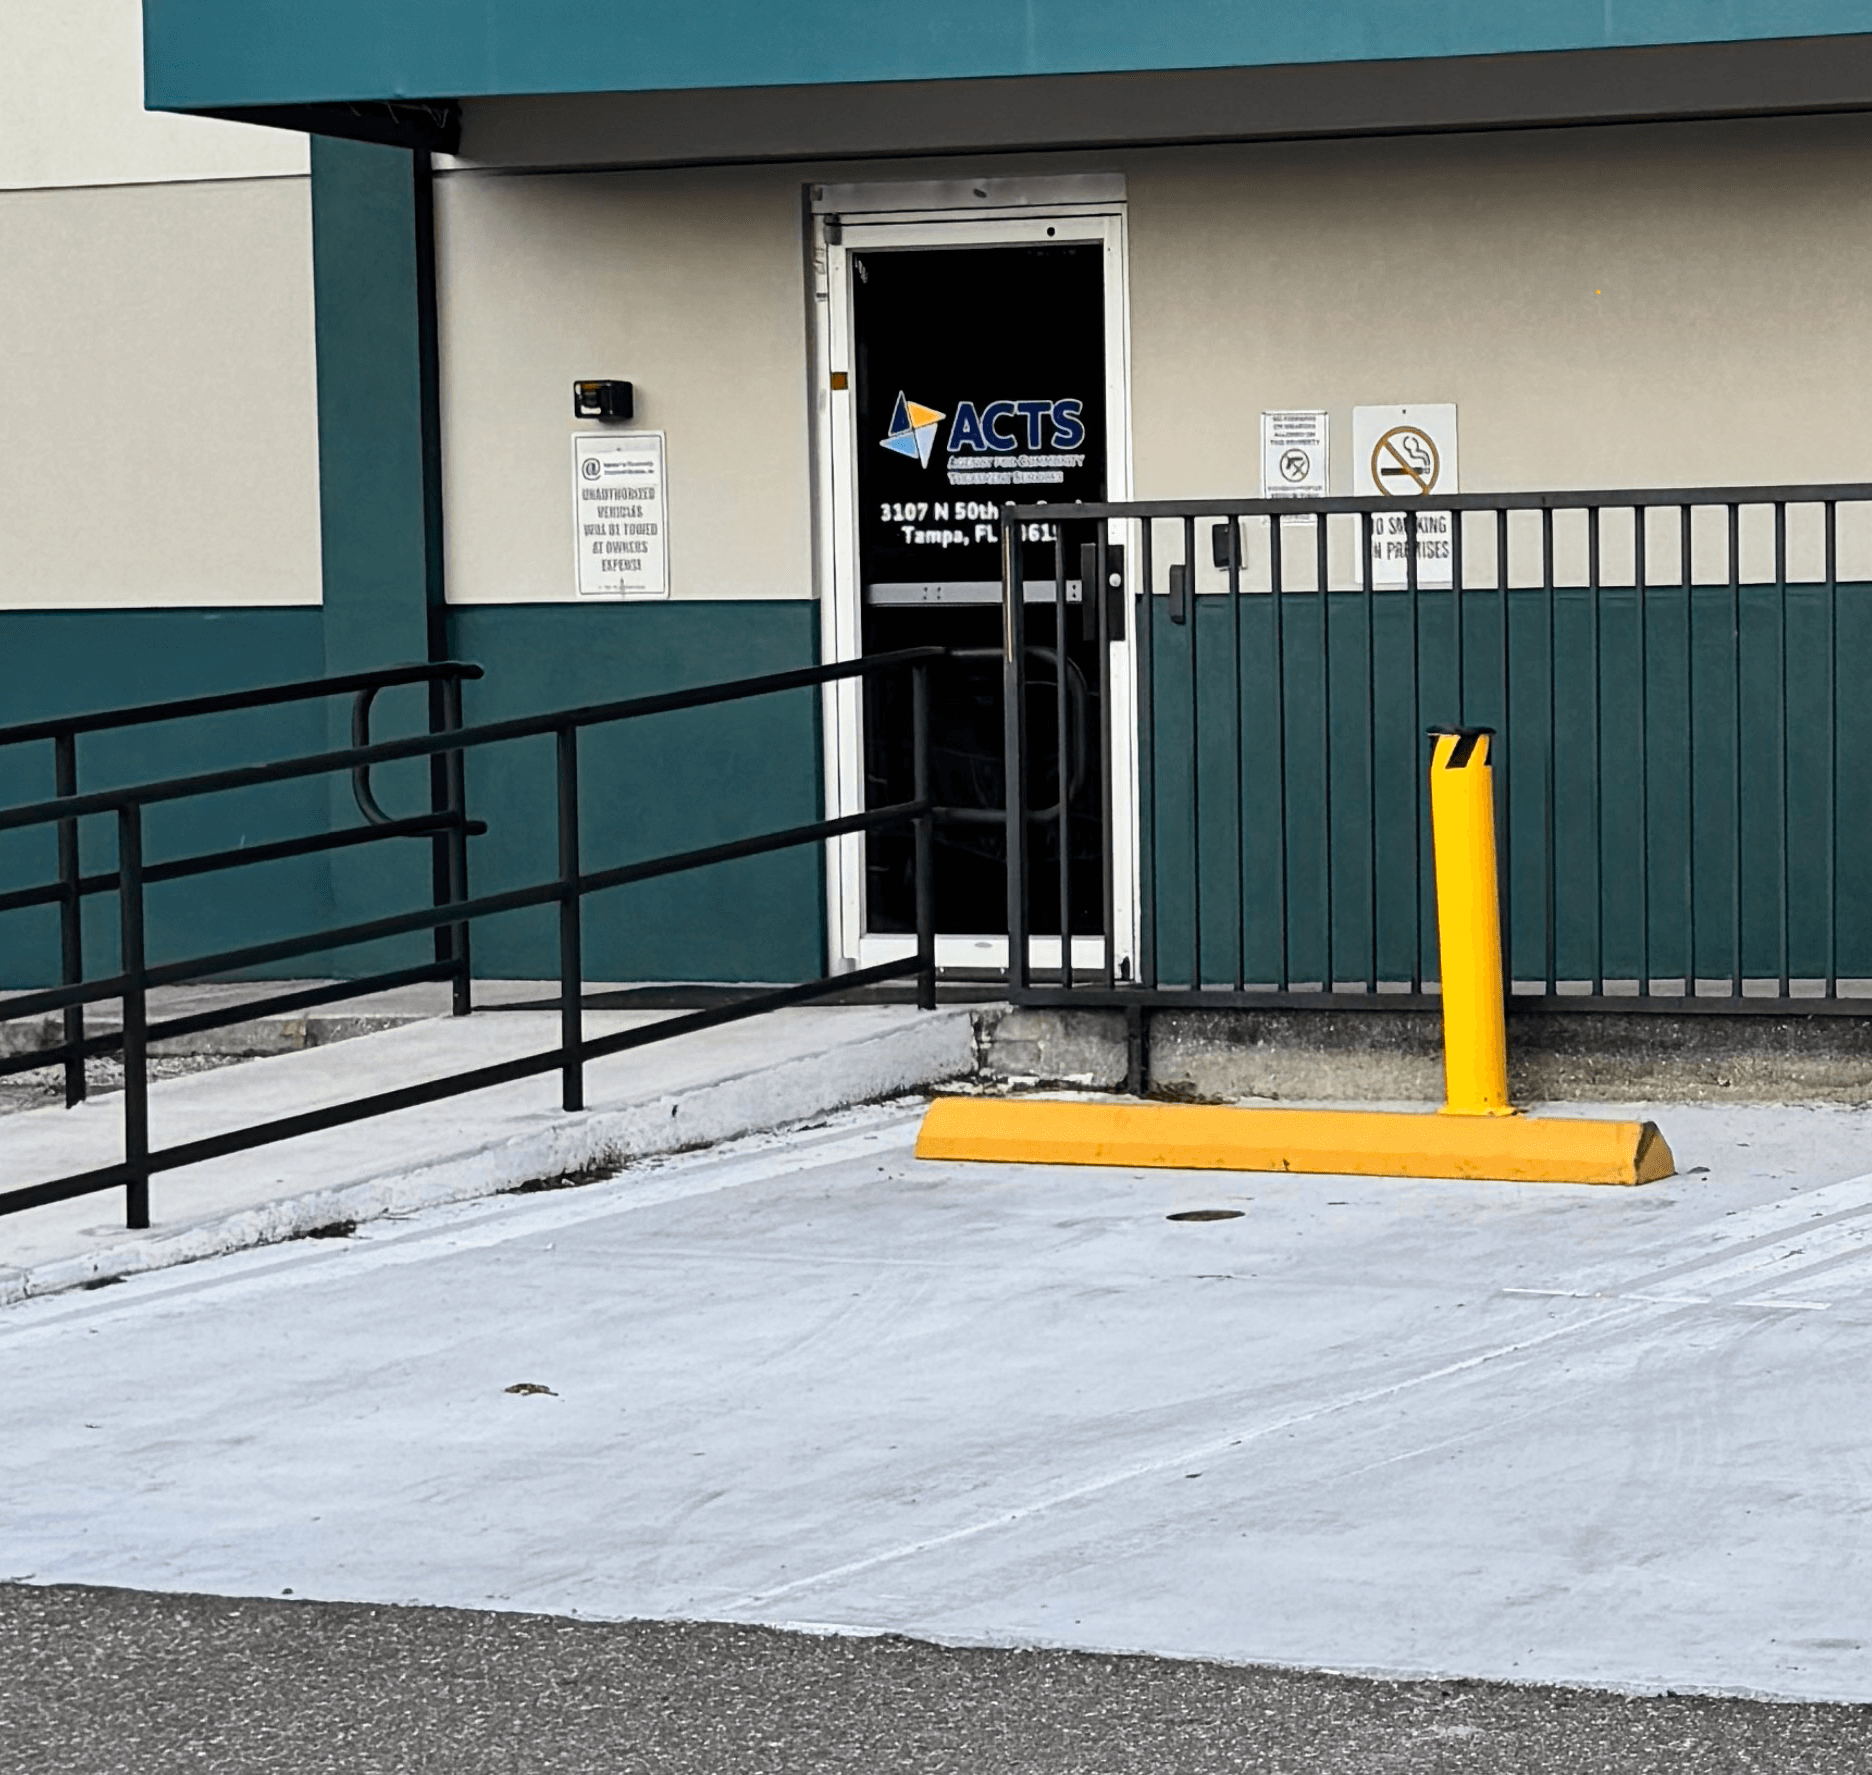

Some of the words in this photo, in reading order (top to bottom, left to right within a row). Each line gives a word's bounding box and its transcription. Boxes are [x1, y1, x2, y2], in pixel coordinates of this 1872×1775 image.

[947, 398, 1085, 452] ACTS
[880, 502, 928, 522] 3107
[934, 502, 949, 521] N
[954, 501, 999, 520] 50th
[901, 525, 970, 548] Tampa,
[975, 524, 998, 543] FL
[1388, 516, 1447, 535] SMKING
